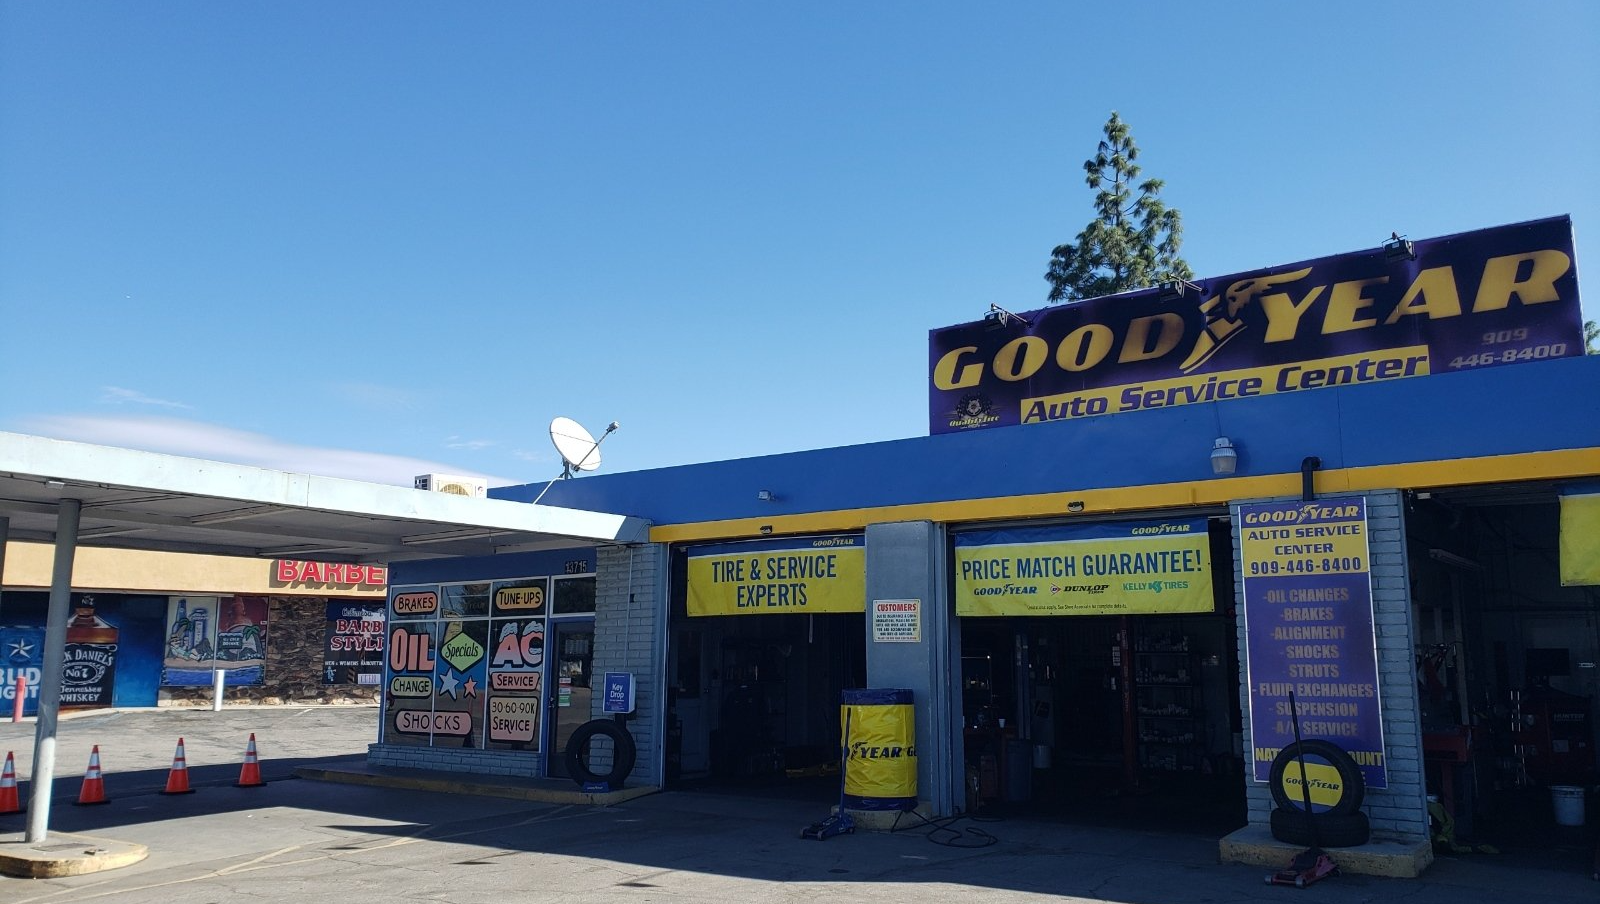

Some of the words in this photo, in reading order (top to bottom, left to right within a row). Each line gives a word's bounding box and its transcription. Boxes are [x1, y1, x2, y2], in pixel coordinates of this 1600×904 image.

[933, 249, 1570, 390] GOODYEAR
[1482, 327, 1529, 346] 909
[1448, 343, 1567, 368] 446-8400
[1022, 395, 1108, 424] Auto
[1120, 376, 1263, 411] Service
[1276, 353, 1429, 392] Center
[1245, 504, 1359, 523] GOODYEAR
[1132, 523, 1190, 535] GOODYEAR
[1248, 529, 1290, 541] AUTO
[1295, 524, 1360, 538] SERVICE
[812, 538, 854, 547] GOODYEAR
[1275, 543, 1334, 555] CENTER
[277, 559, 388, 585] BARBE
[711, 559, 745, 583] TIRE
[750, 558, 761, 580] &
[766, 554, 837, 580] SERVICE
[962, 559, 1011, 580] PRICE
[1016, 555, 1076, 578] MATCH
[1083, 549, 1202, 577] GUARANTEE!
[1250, 556, 1361, 575] 909-446-8400
[973, 583, 1037, 596] GOODYEAR
[1063, 584, 1109, 592] DUNLOP
[1123, 582, 1147, 591] KELLY
[1163, 580, 1189, 590] TIRES
[737, 582, 807, 607] EXPERTS
[1290, 588, 1349, 602] CHANGES
[398, 596, 434, 611] BRAKES
[877, 603, 917, 612] CUSTOMERS
[330, 635, 384, 651] STYLI
[390, 628, 435, 671] OIL
[492, 620, 544, 669] AC
[445, 642, 479, 662] Specials
[1286, 645, 1340, 659] SHOCKS
[496, 671, 534, 687] SERVICE
[1288, 664, 1340, 678] STRUTS
[393, 678, 430, 693] CHANGE
[611, 683, 624, 692] Key
[1297, 683, 1374, 698] EXCHANGES
[59, 693, 100, 702] WHISKEY
[610, 690, 625, 700] Drop
[1275, 701, 1359, 717] SUSPENSION
[403, 712, 460, 730] SHOCKS
[492, 716, 530, 735] SERVICE
[1303, 722, 1359, 737] SERVICE
[1255, 747, 1283, 762] NAT
